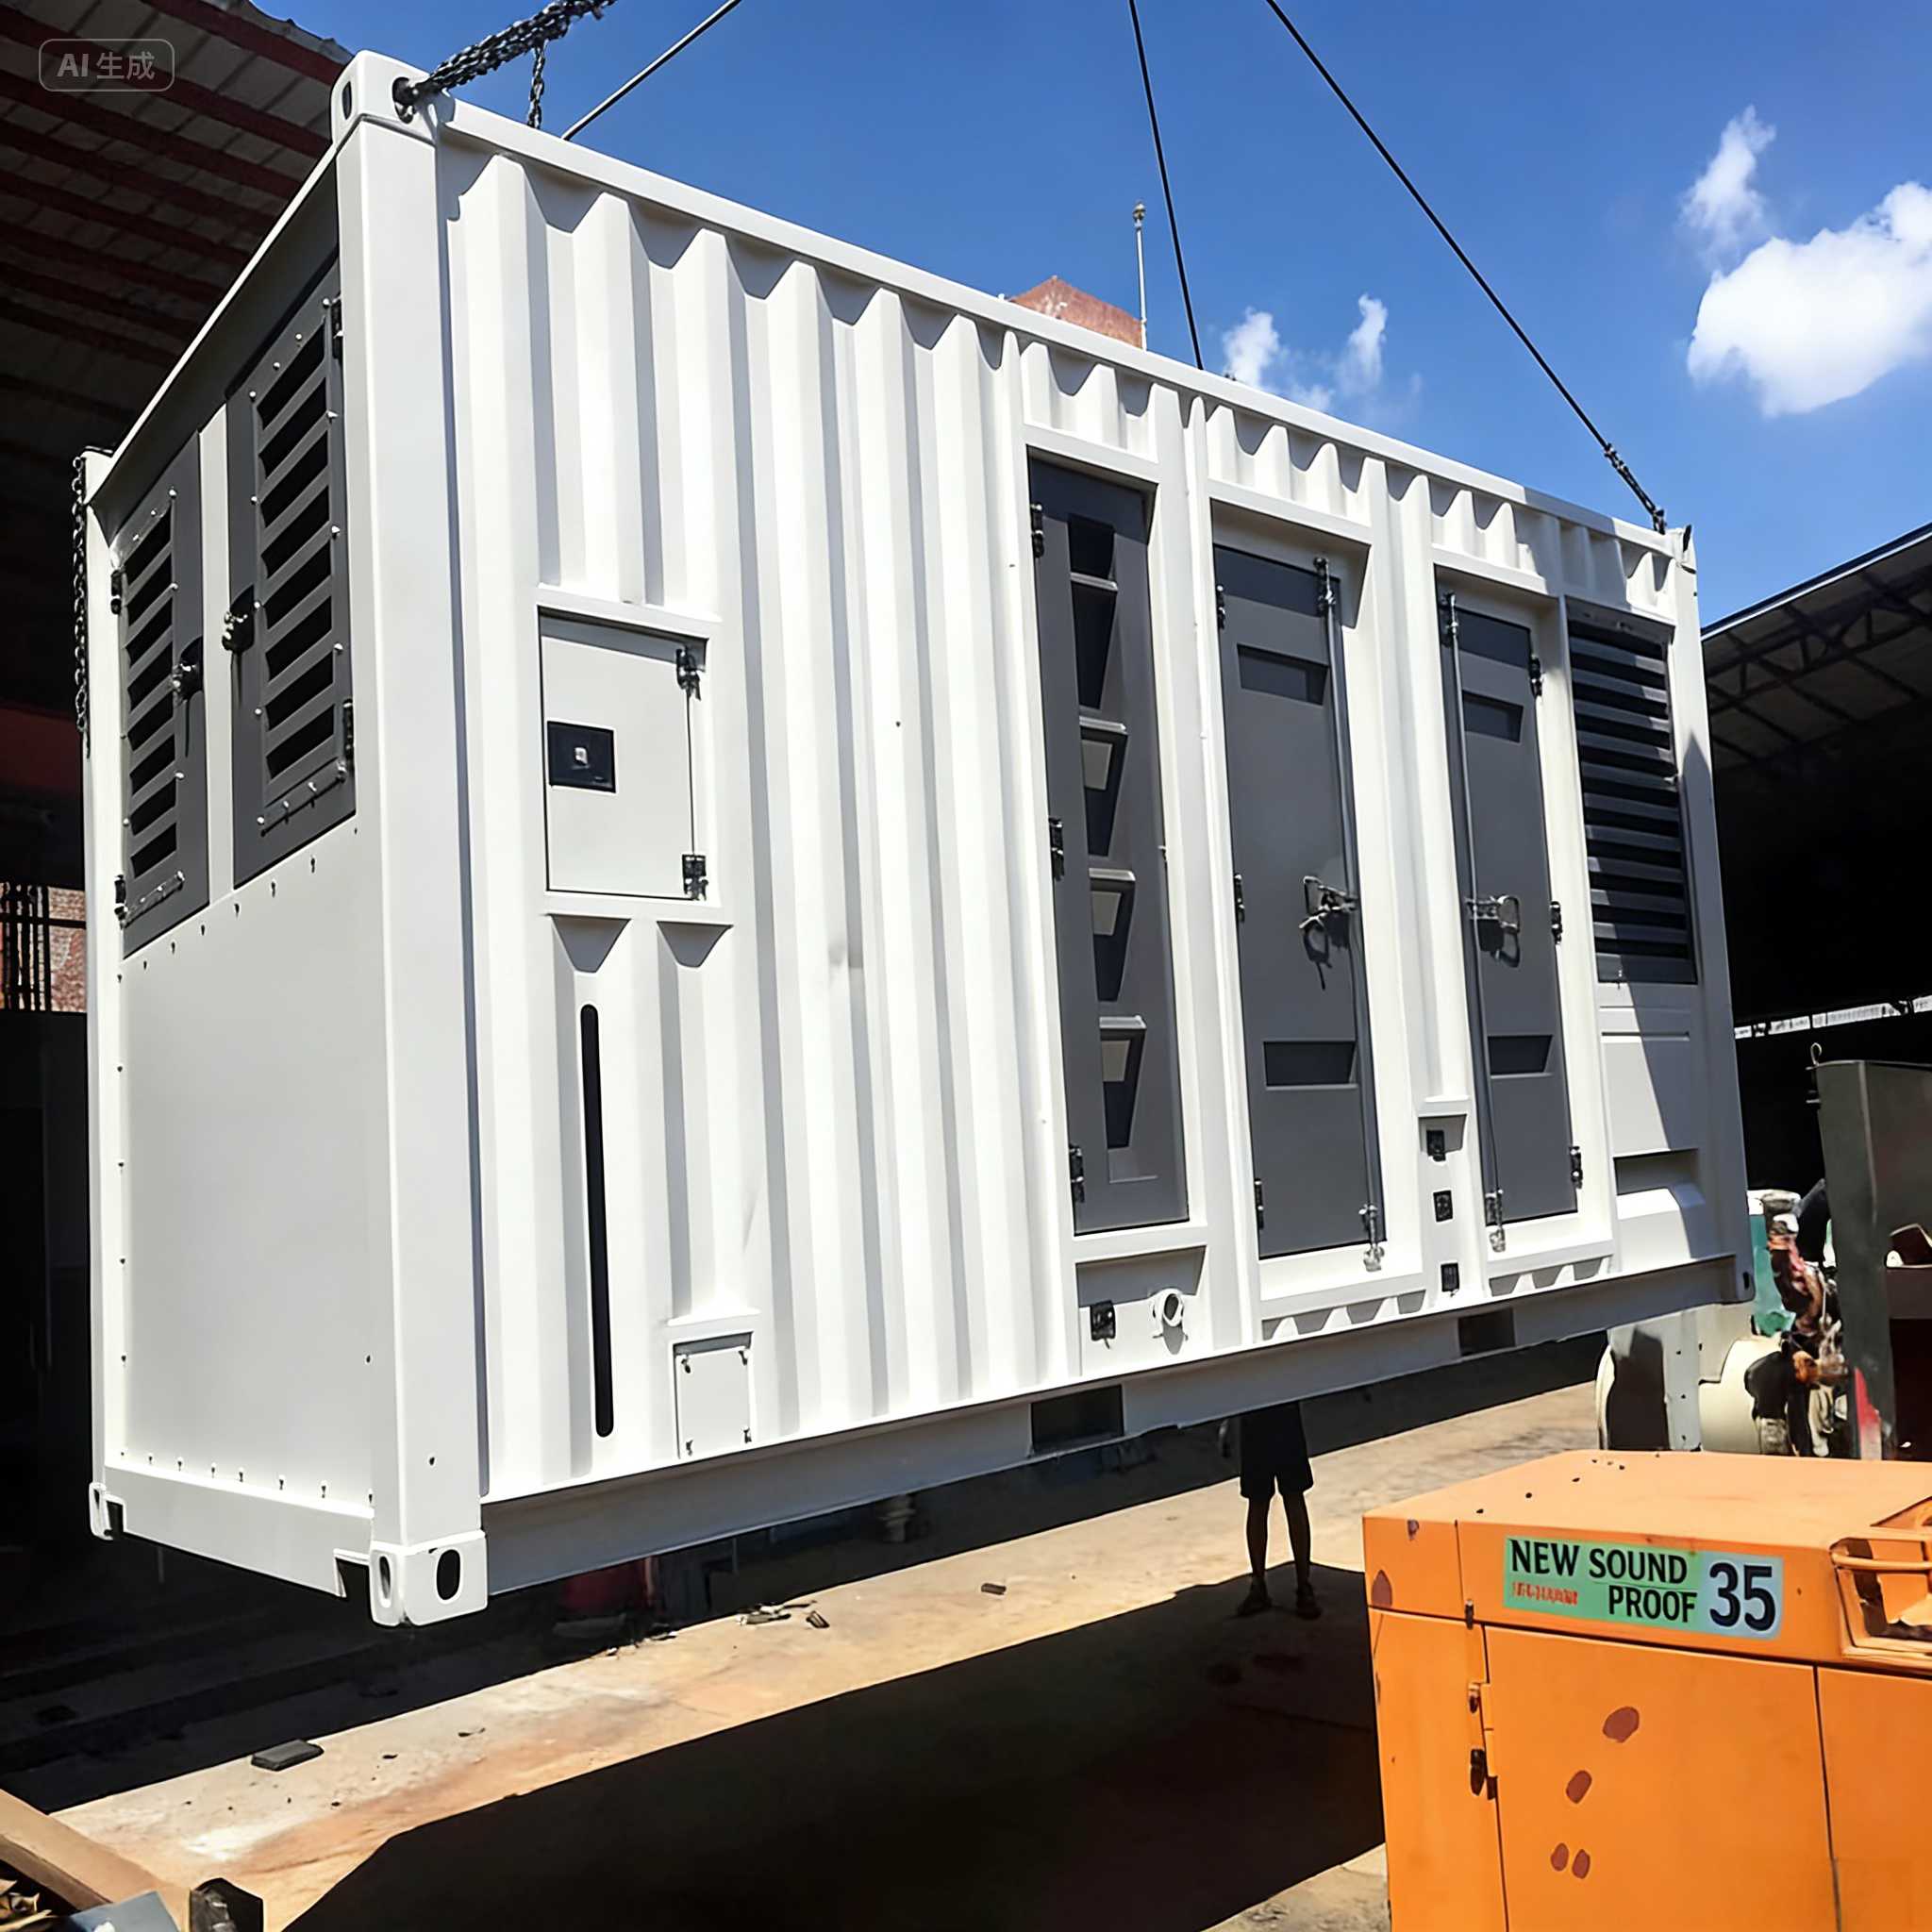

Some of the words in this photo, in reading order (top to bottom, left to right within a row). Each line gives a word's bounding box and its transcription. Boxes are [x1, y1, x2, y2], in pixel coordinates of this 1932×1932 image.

[1510, 1539, 1580, 1576] NEW
[1589, 1548, 1688, 1584] SOUND
[1608, 1585, 1697, 1623] PROOF
[1708, 1562, 1776, 1631] 35
